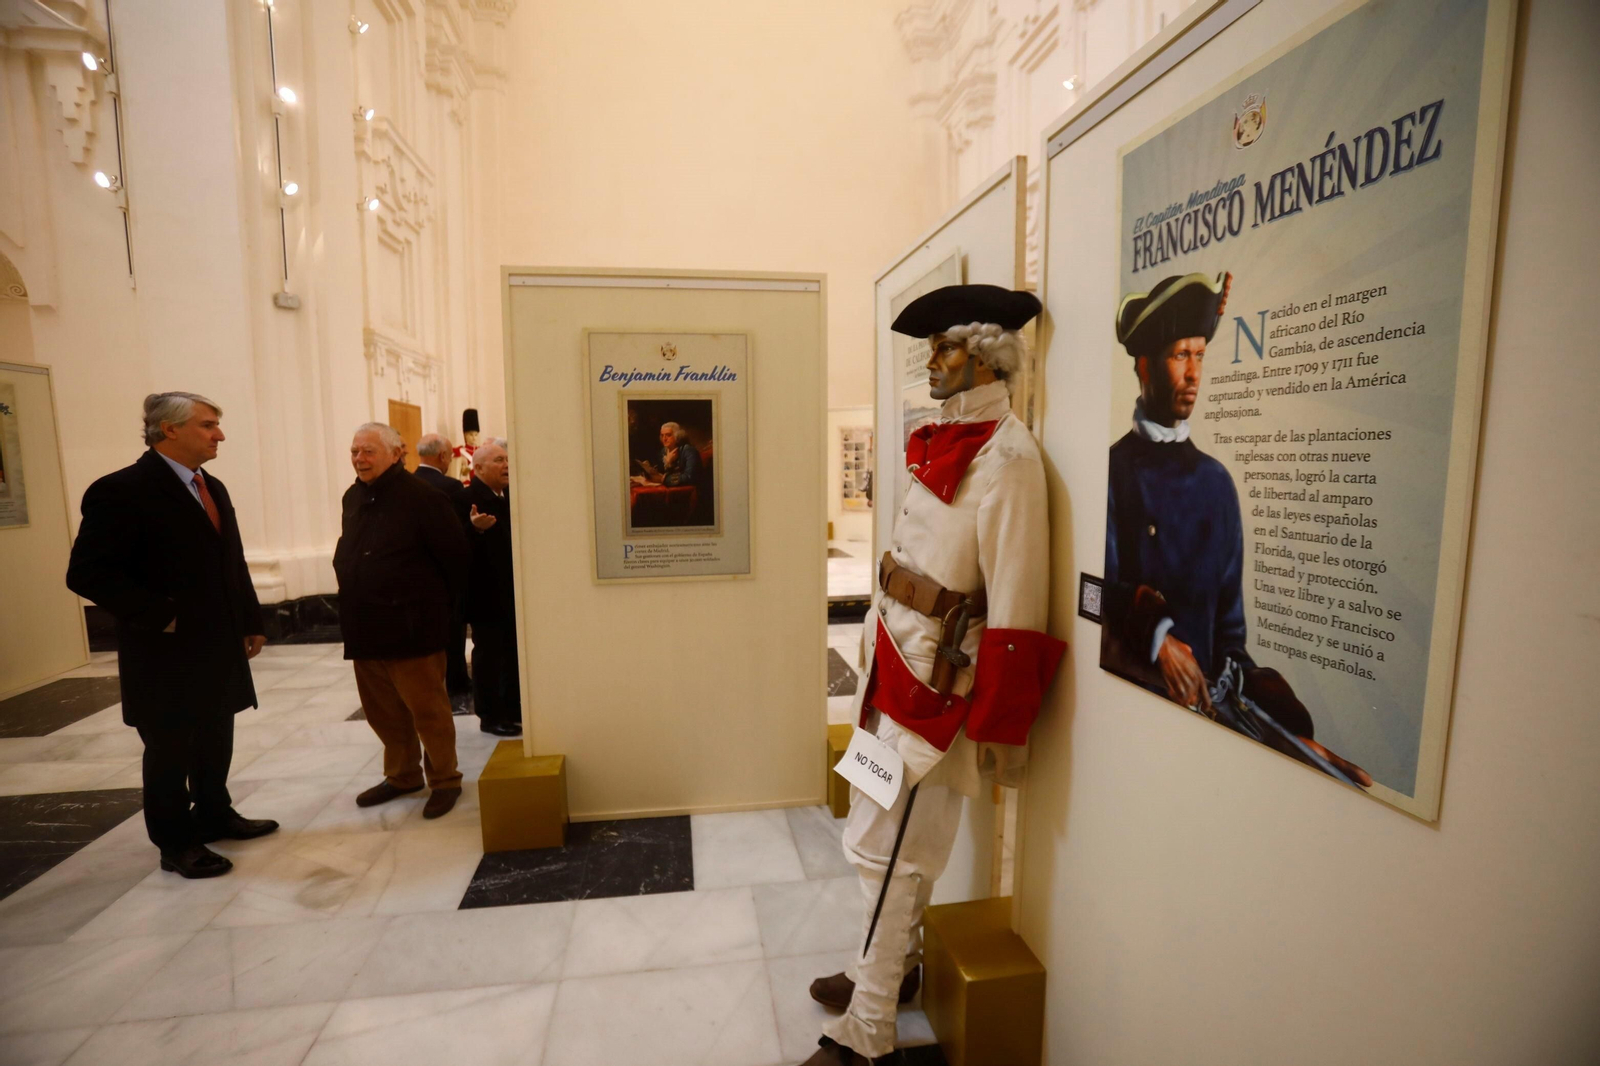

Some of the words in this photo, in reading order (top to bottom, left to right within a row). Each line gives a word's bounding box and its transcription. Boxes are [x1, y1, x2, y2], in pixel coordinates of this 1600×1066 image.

[1132, 189, 1245, 273] FRANCISCO
[1252, 98, 1445, 228] MENÉNDEZ
[1134, 217, 1144, 234] El
[1146, 201, 1184, 227] Capitán
[1187, 173, 1246, 208] Mandinga
[1303, 302, 1318, 313] en
[1320, 294, 1332, 309] el
[1335, 286, 1388, 304] margen
[1269, 342, 1316, 358] Gambia,
[1319, 336, 1334, 350] de
[1337, 321, 1426, 348] ascendencia
[1270, 323, 1316, 339] africano
[1319, 314, 1338, 330] del
[1342, 311, 1364, 326] Río
[599, 364, 672, 388] Benjamin
[674, 364, 738, 382] Franklin
[1211, 370, 1260, 385] mandinga.
[1262, 365, 1292, 378] Entre
[1294, 362, 1318, 376] 1709
[1321, 360, 1329, 374] y
[1332, 357, 1352, 372] 1711
[1356, 352, 1380, 366] fue
[1208, 384, 1256, 404] capturado
[1258, 388, 1264, 401] y
[1266, 380, 1310, 397] vendido
[1313, 382, 1328, 392] en
[1331, 378, 1342, 390] la
[1345, 372, 1406, 389] América
[1204, 406, 1262, 422] anglosajona.
[1214, 433, 1232, 444] Tras
[1234, 434, 1272, 446] escapar
[1274, 430, 1288, 442] de
[1290, 430, 1306, 442] las
[1308, 428, 1392, 445] plantaciones
[1235, 450, 1274, 464] inglesas
[1277, 452, 1296, 462] con
[1300, 450, 1328, 462] otras
[1332, 452, 1371, 462] nueve
[1244, 470, 1293, 484] personas,
[1296, 468, 1326, 485] logró
[1329, 470, 1340, 483] la
[1343, 473, 1377, 484] carta
[1249, 486, 1262, 498] de
[1264, 487, 1306, 502] libertad
[1308, 489, 1320, 502] al
[1322, 494, 1373, 508] amparo
[1252, 505, 1264, 518] de
[1266, 506, 1281, 518] las
[1283, 507, 1311, 524] leyes
[1314, 513, 1378, 528] españolas
[1254, 526, 1266, 536] en
[1268, 526, 1278, 538] el
[1280, 526, 1338, 546] Santuario
[1340, 533, 1358, 548] de
[1360, 535, 1372, 550] la
[1254, 542, 1296, 560] Florida,
[1298, 551, 1320, 564] que
[1323, 552, 1340, 566] les
[1343, 559, 1387, 576] otorgó
[1254, 560, 1295, 578] libertad
[1298, 570, 1304, 583] y
[1307, 573, 1378, 594] protección.
[1254, 579, 1276, 594] Una
[1278, 586, 1295, 598] vez
[1298, 587, 1325, 604] libre
[1328, 596, 1336, 610] y
[1338, 598, 1346, 608] a
[1348, 599, 1383, 617] salvo
[1386, 609, 1402, 620] se
[1254, 597, 1293, 616] bautizó
[1296, 610, 1328, 625] como
[1330, 614, 1396, 642] Francisco
[1256, 616, 1314, 642] Menéndez
[1316, 636, 1324, 648] y
[1326, 638, 1340, 648] se
[1342, 640, 1374, 658] unió
[1376, 652, 1385, 662] a
[1256, 634, 1272, 648] las
[1274, 641, 1308, 660] tropas
[1310, 651, 1376, 681] españolas.
[854, 752, 868, 766] NO
[868, 760, 893, 785] TOCAR
